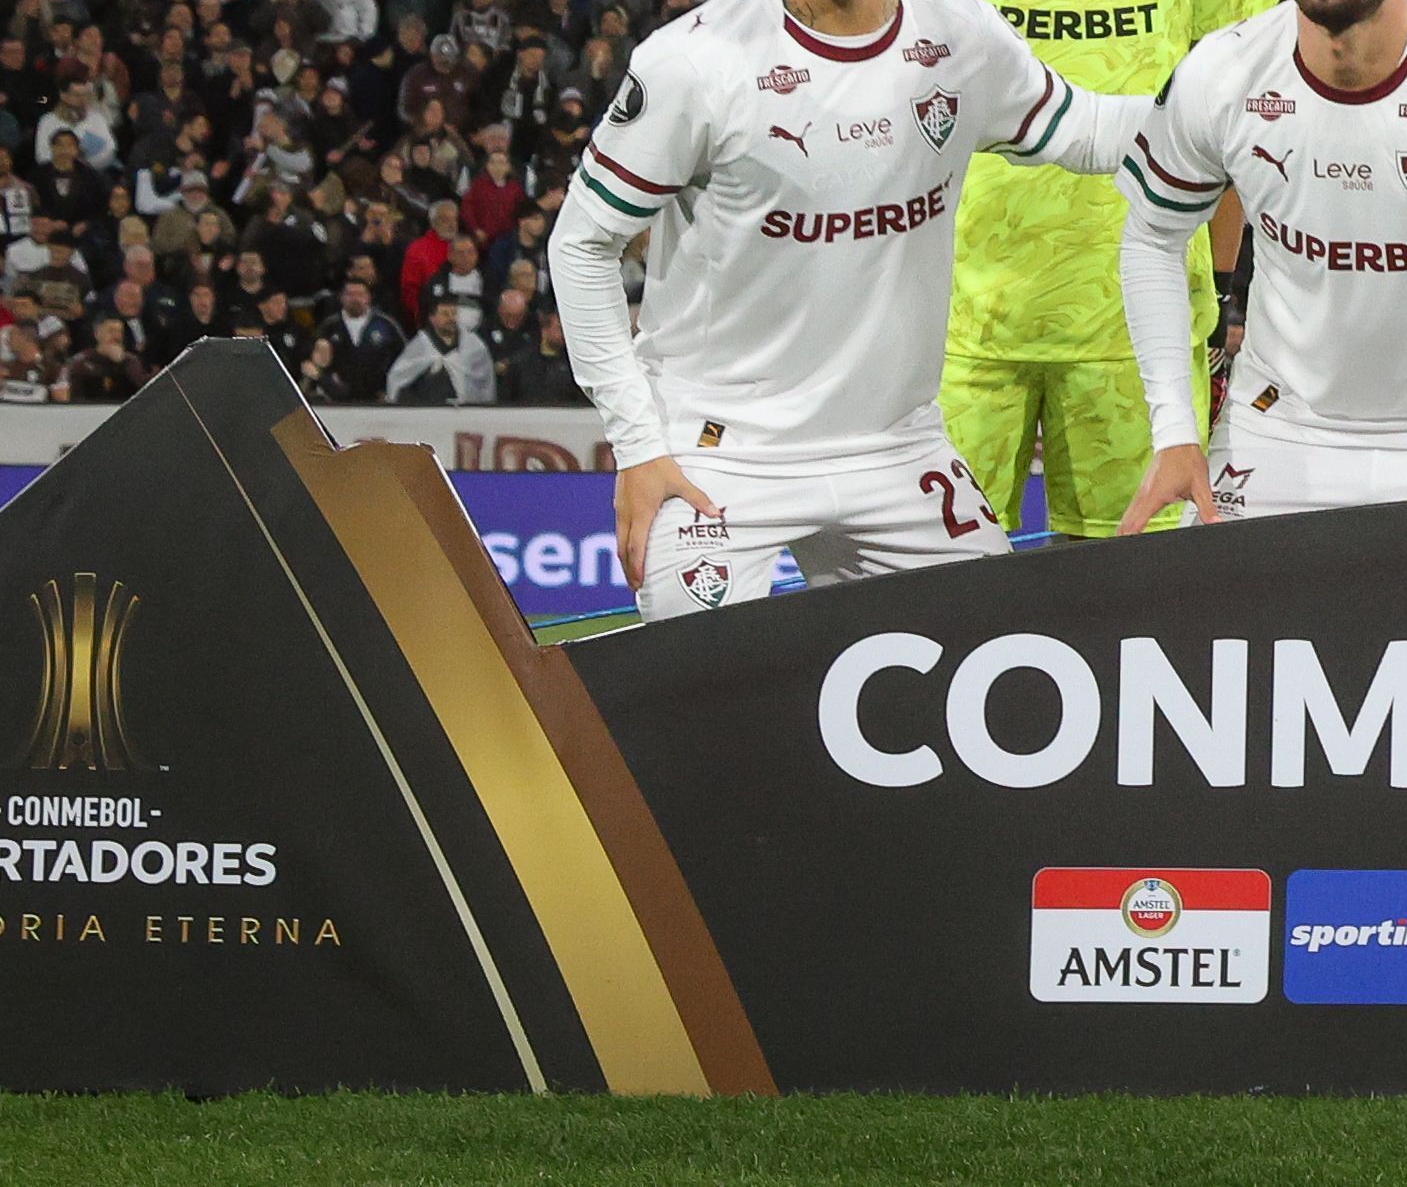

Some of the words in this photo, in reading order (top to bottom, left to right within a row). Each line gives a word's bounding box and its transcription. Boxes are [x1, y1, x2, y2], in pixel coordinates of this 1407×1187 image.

[995, 2, 1158, 41] PERBET
[1247, 99, 1295, 113] FRESCATTO
[837, 116, 892, 142] Leve
[1314, 159, 1372, 180] Leve
[1212, 491, 1245, 507] EGA
[678, 524, 730, 540] MEGA
[1134, 900, 1170, 910] AMSTEL
[0, 913, 106, 942] RIA
[146, 915, 341, 947] ETERNA
[1057, 947, 1241, 988] AMSTEL
